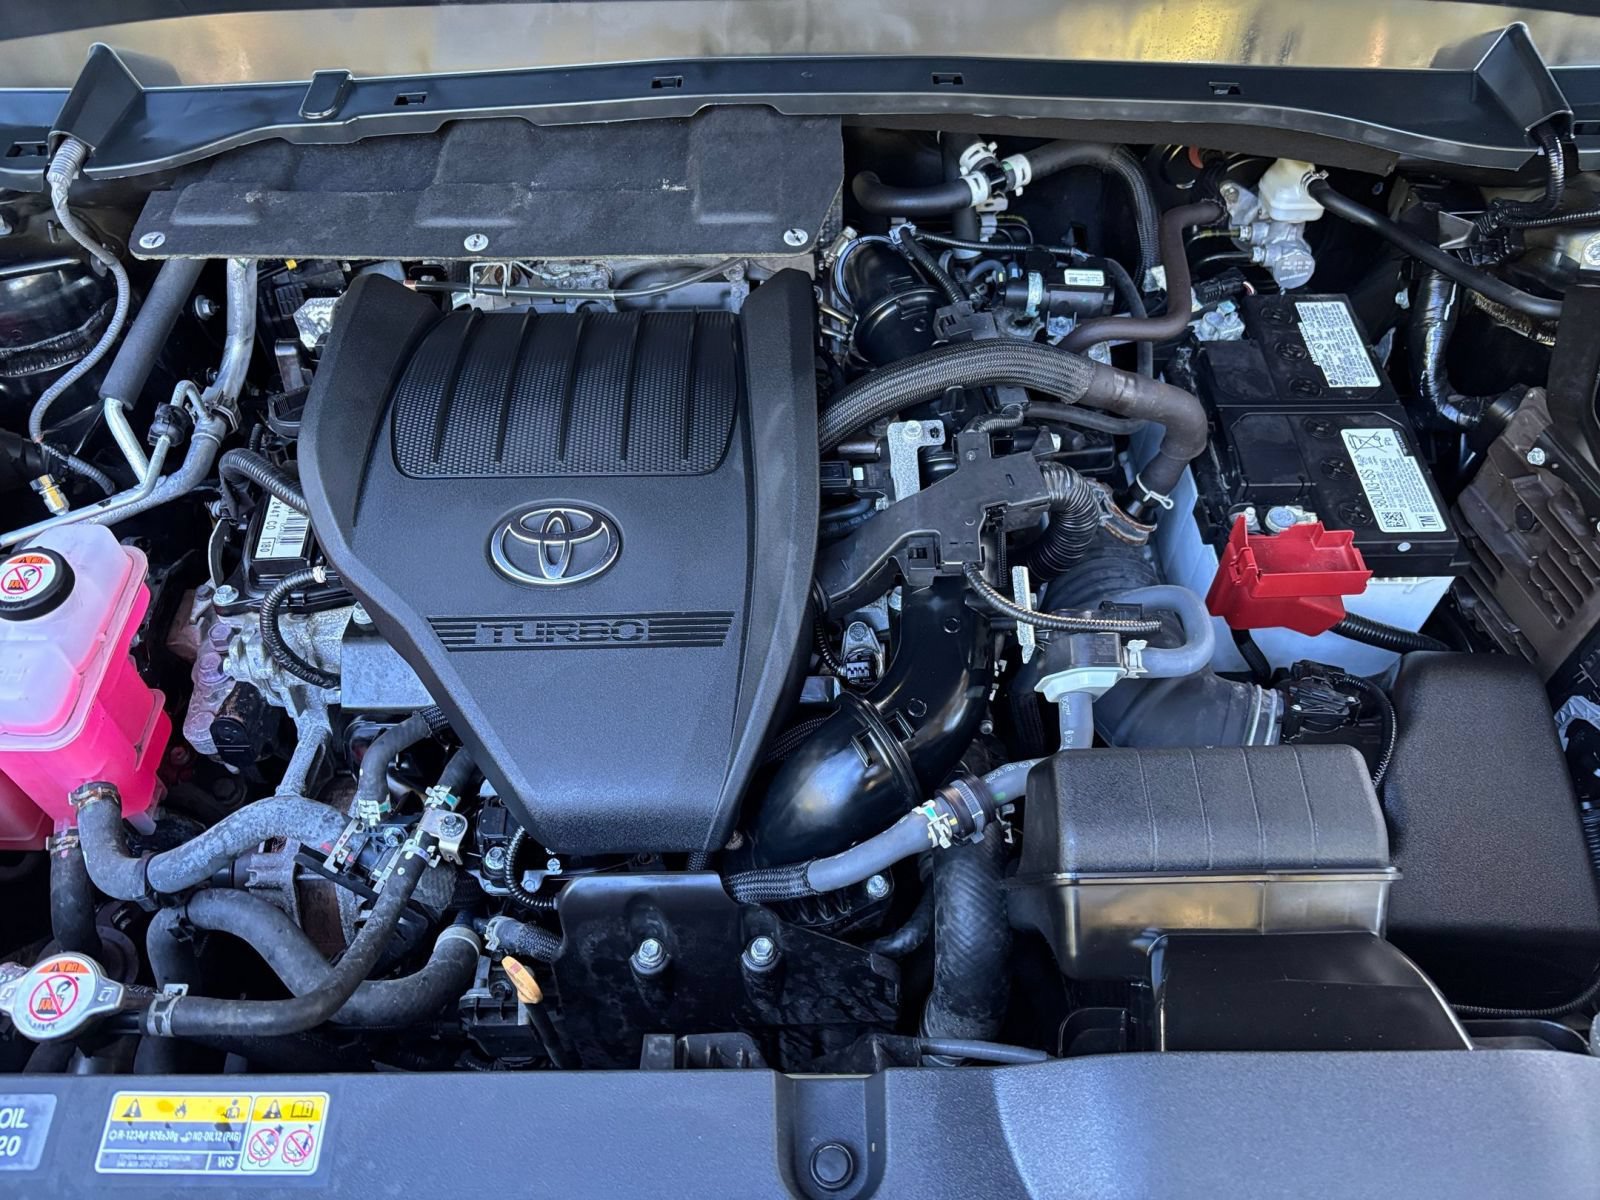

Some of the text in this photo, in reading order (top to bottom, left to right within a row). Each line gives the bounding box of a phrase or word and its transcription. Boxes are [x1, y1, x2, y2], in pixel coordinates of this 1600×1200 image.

[1420, 515, 1437, 527] TM
[478, 619, 647, 643] TURBO
[0, 1107, 29, 1129] OIL
[217, 1156, 235, 1169] WS
